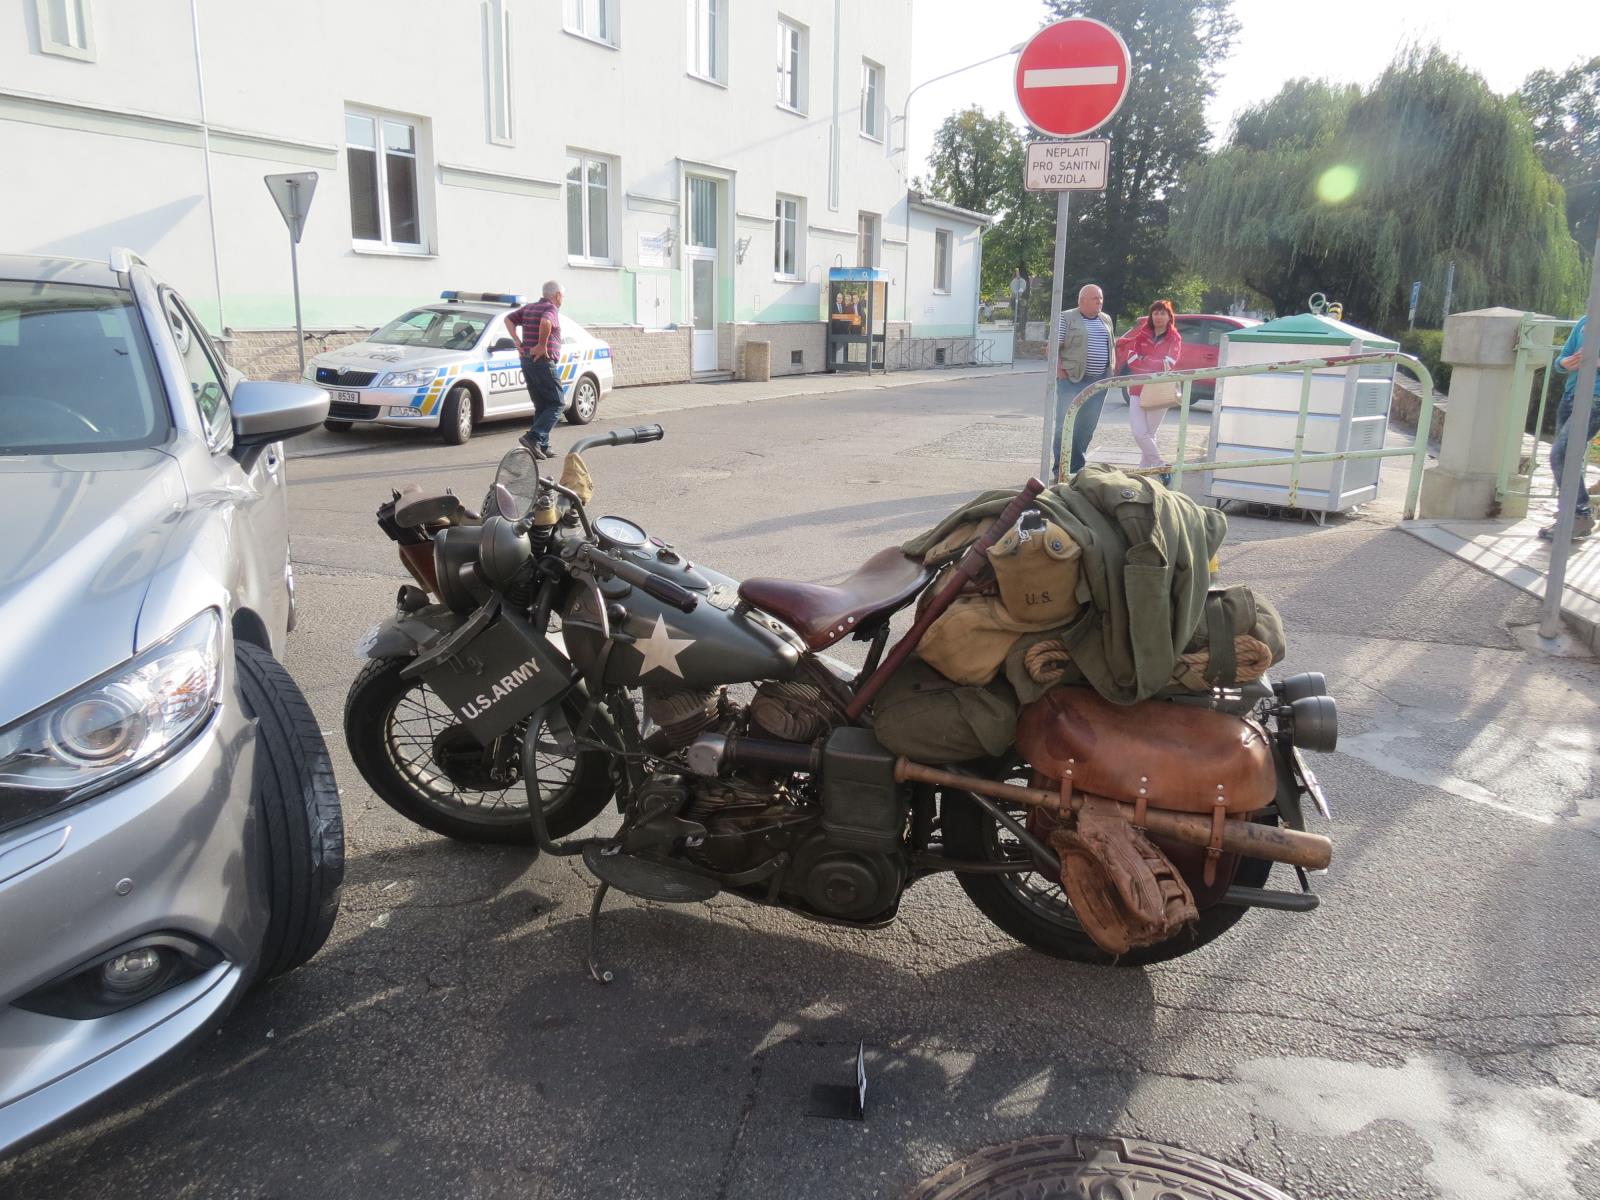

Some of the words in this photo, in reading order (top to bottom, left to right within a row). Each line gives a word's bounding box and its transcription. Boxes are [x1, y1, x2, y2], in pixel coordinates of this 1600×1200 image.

[1033, 161, 1053, 171] PRO
[1044, 174, 1086, 184] VOZIDLA
[490, 370, 526, 389] POLIC
[338, 391, 355, 402] 8539
